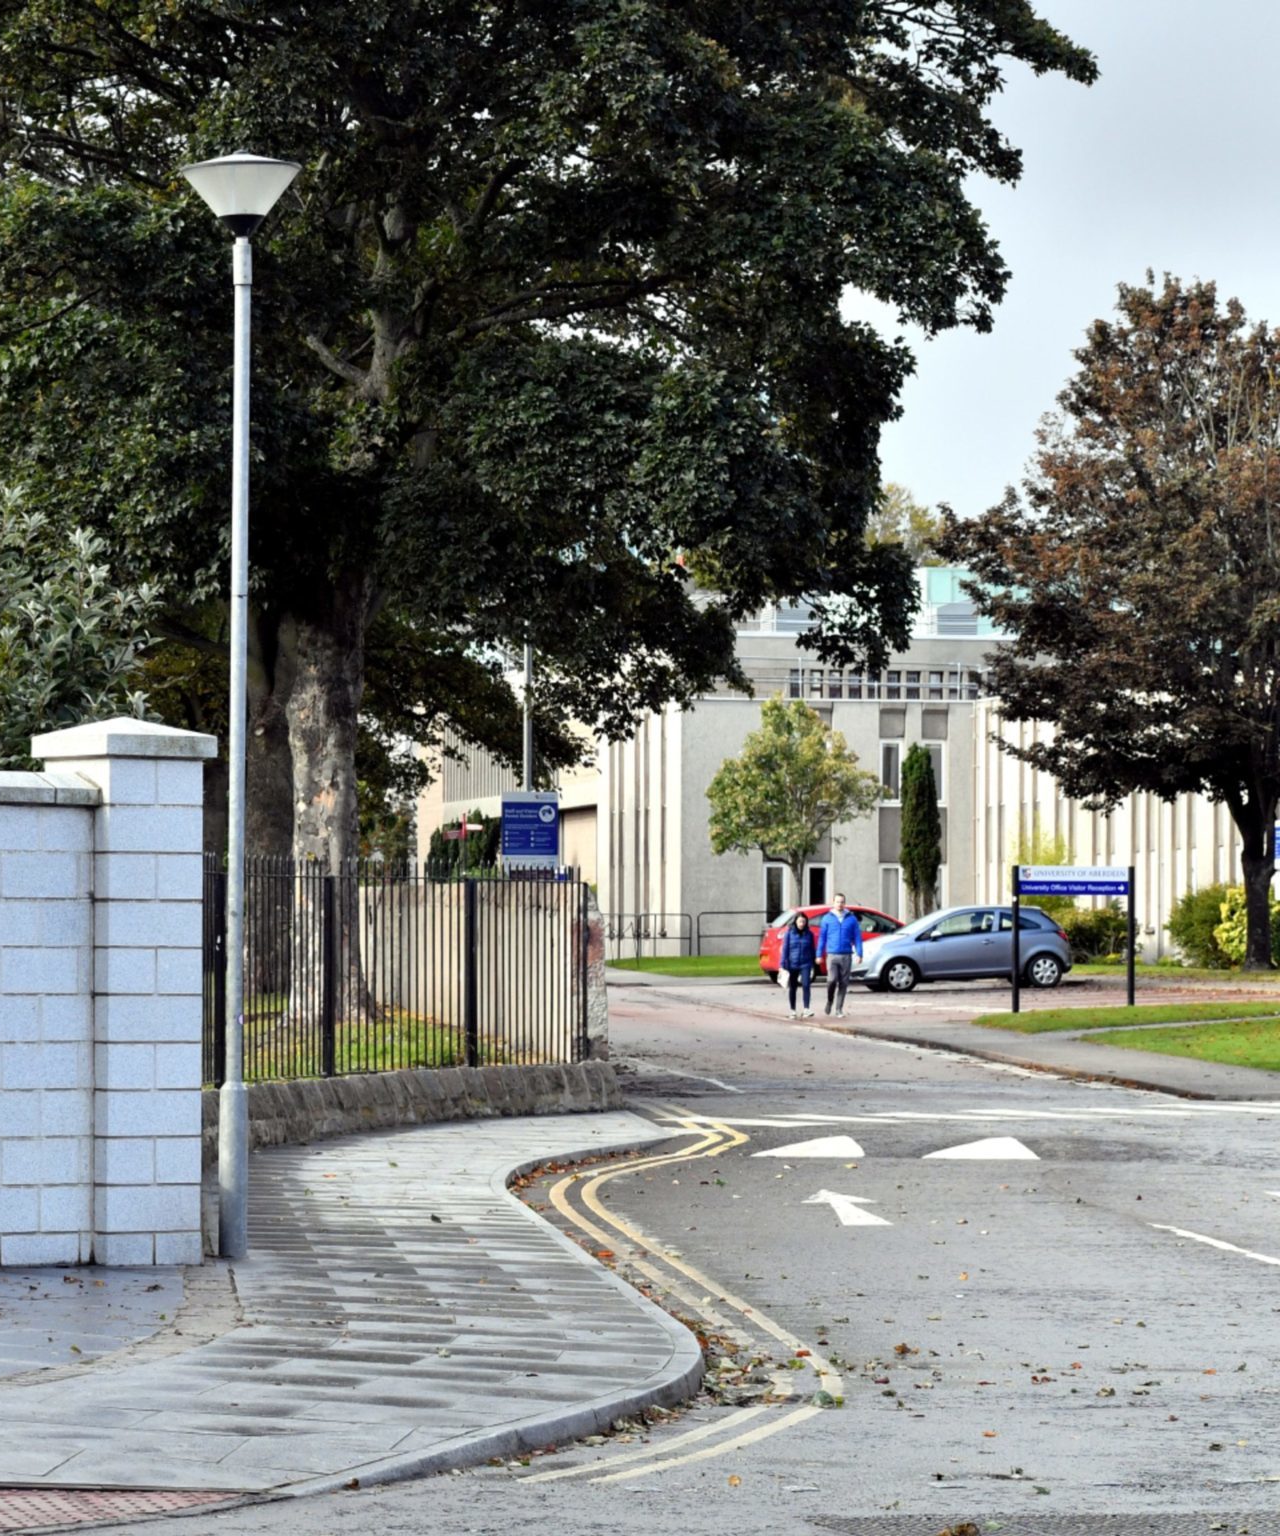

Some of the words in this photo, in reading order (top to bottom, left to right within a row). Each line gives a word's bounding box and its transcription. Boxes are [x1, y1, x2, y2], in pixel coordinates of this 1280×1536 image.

[1034, 870, 1076, 878] UNIVERSITY
[1077, 870, 1086, 878] OF
[1089, 870, 1126, 878] ABERDEEN
[1021, 884, 1049, 892] University
[1088, 884, 1117, 892] Reception
